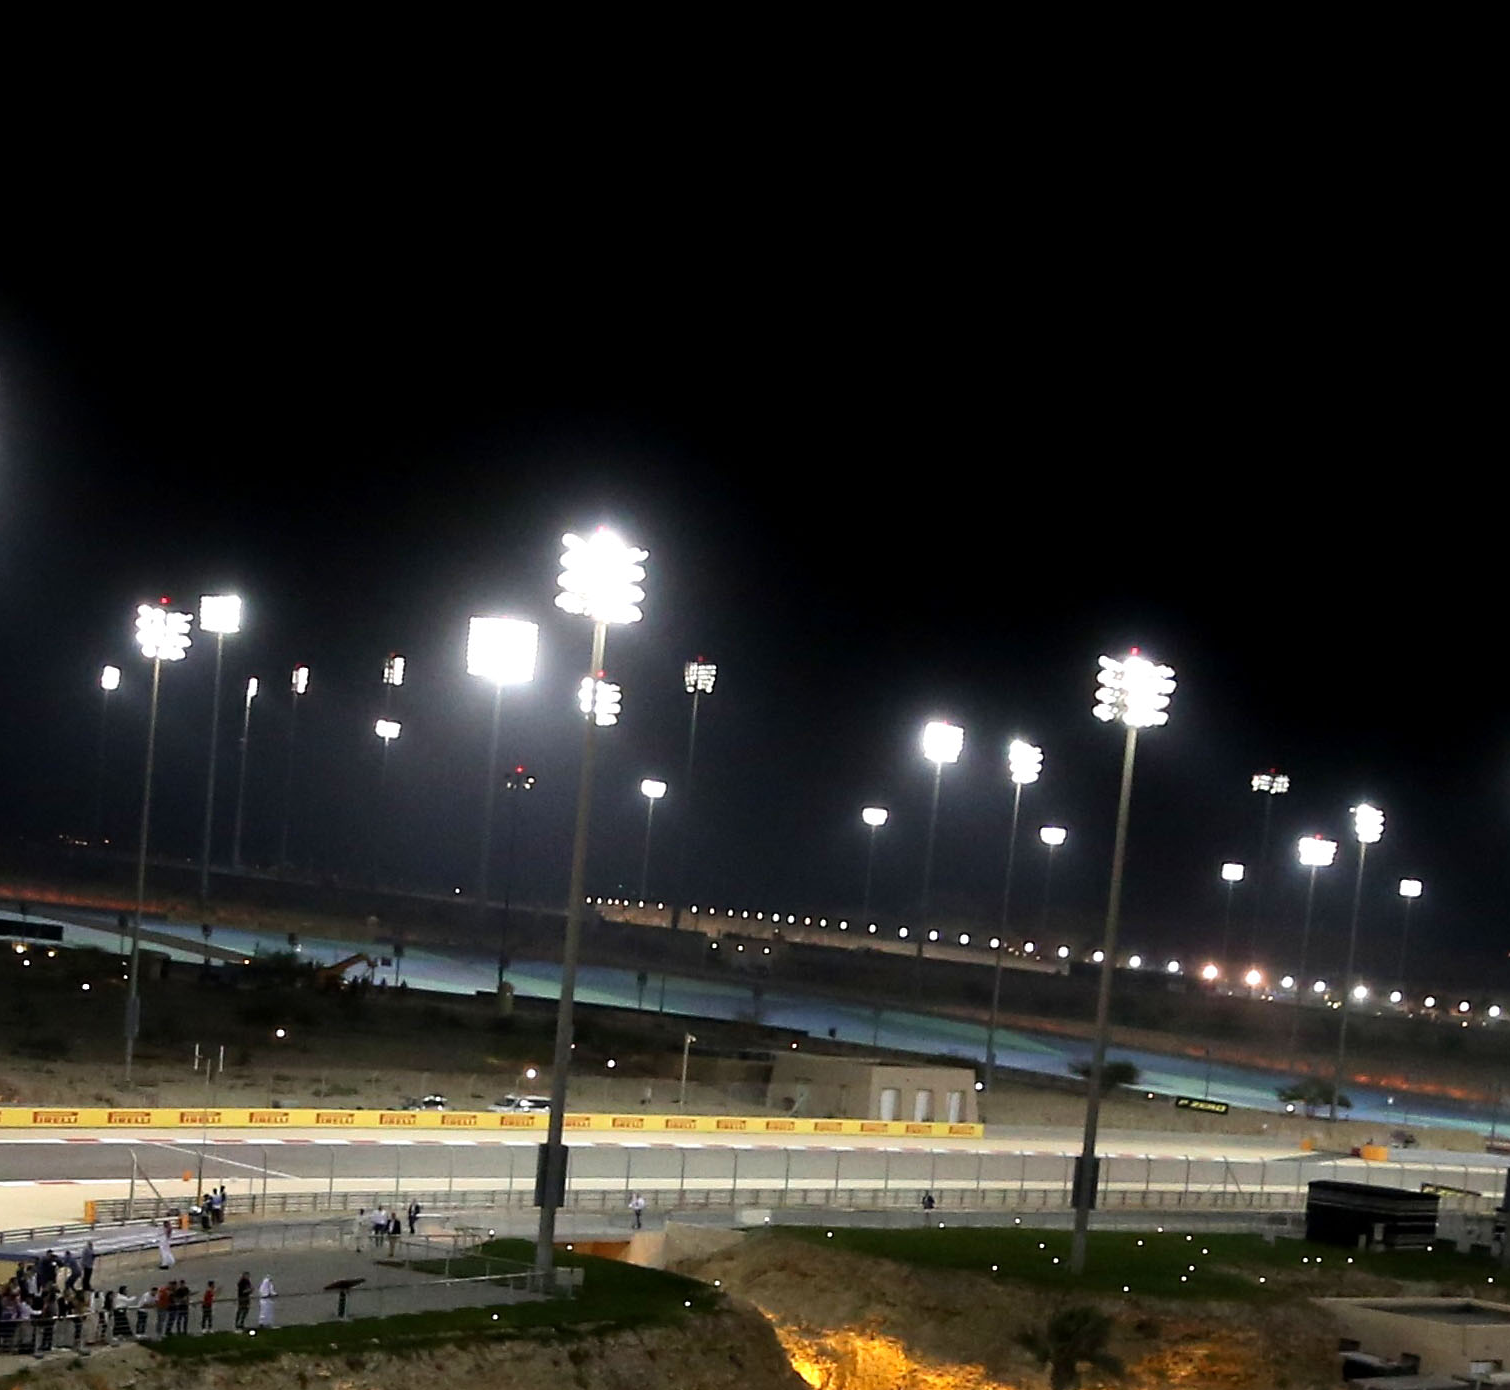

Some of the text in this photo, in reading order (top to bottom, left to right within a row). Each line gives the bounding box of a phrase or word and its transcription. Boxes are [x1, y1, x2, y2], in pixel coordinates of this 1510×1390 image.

[32, 1111, 79, 1124] PIRELLI
[107, 1111, 151, 1124] PIRELLI
[179, 1111, 222, 1124] PIRELLI
[249, 1112, 289, 1125] PIRELLI
[315, 1112, 355, 1125] PIRELLI
[562, 1116, 591, 1128] IRELLI
